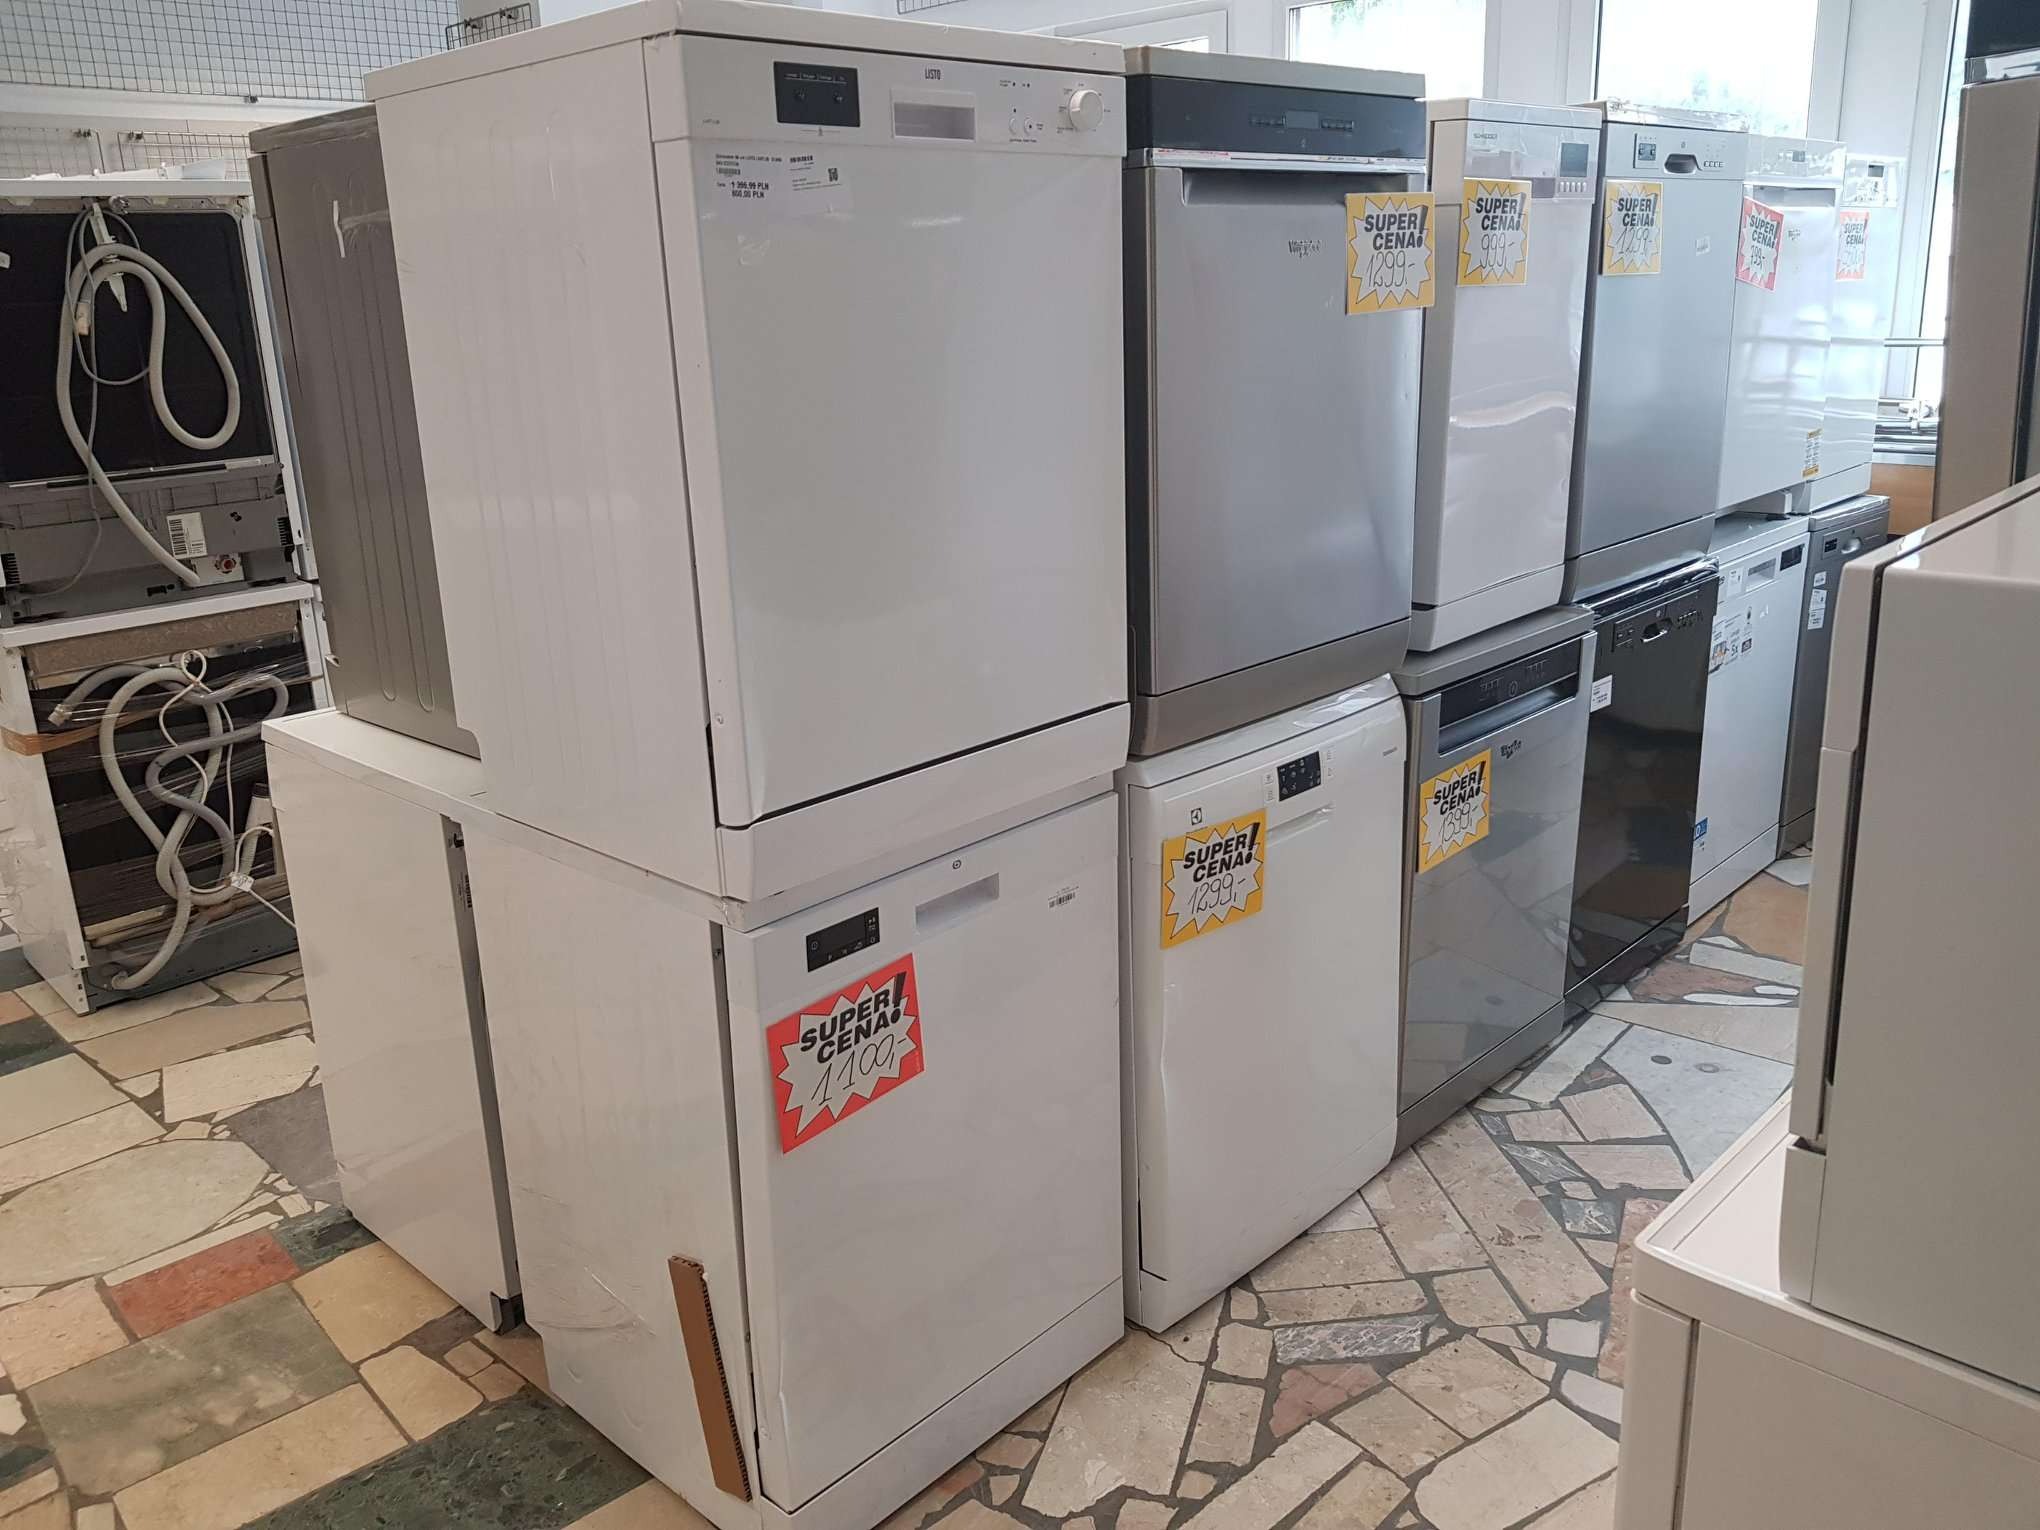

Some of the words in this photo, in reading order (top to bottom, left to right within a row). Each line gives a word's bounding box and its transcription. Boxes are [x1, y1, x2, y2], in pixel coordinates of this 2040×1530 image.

[924, 68, 942, 80] LISTO
[1475, 197, 1518, 214] SUPER
[1617, 197, 1651, 212] SUPER
[1364, 212, 1418, 233] SUPER
[1750, 215, 1775, 236] SUPER
[1844, 223, 1863, 234] SUPER
[1433, 770, 1477, 806] SUPER
[1184, 832, 1248, 870] SUPER
[800, 989, 897, 1053] SUPER
